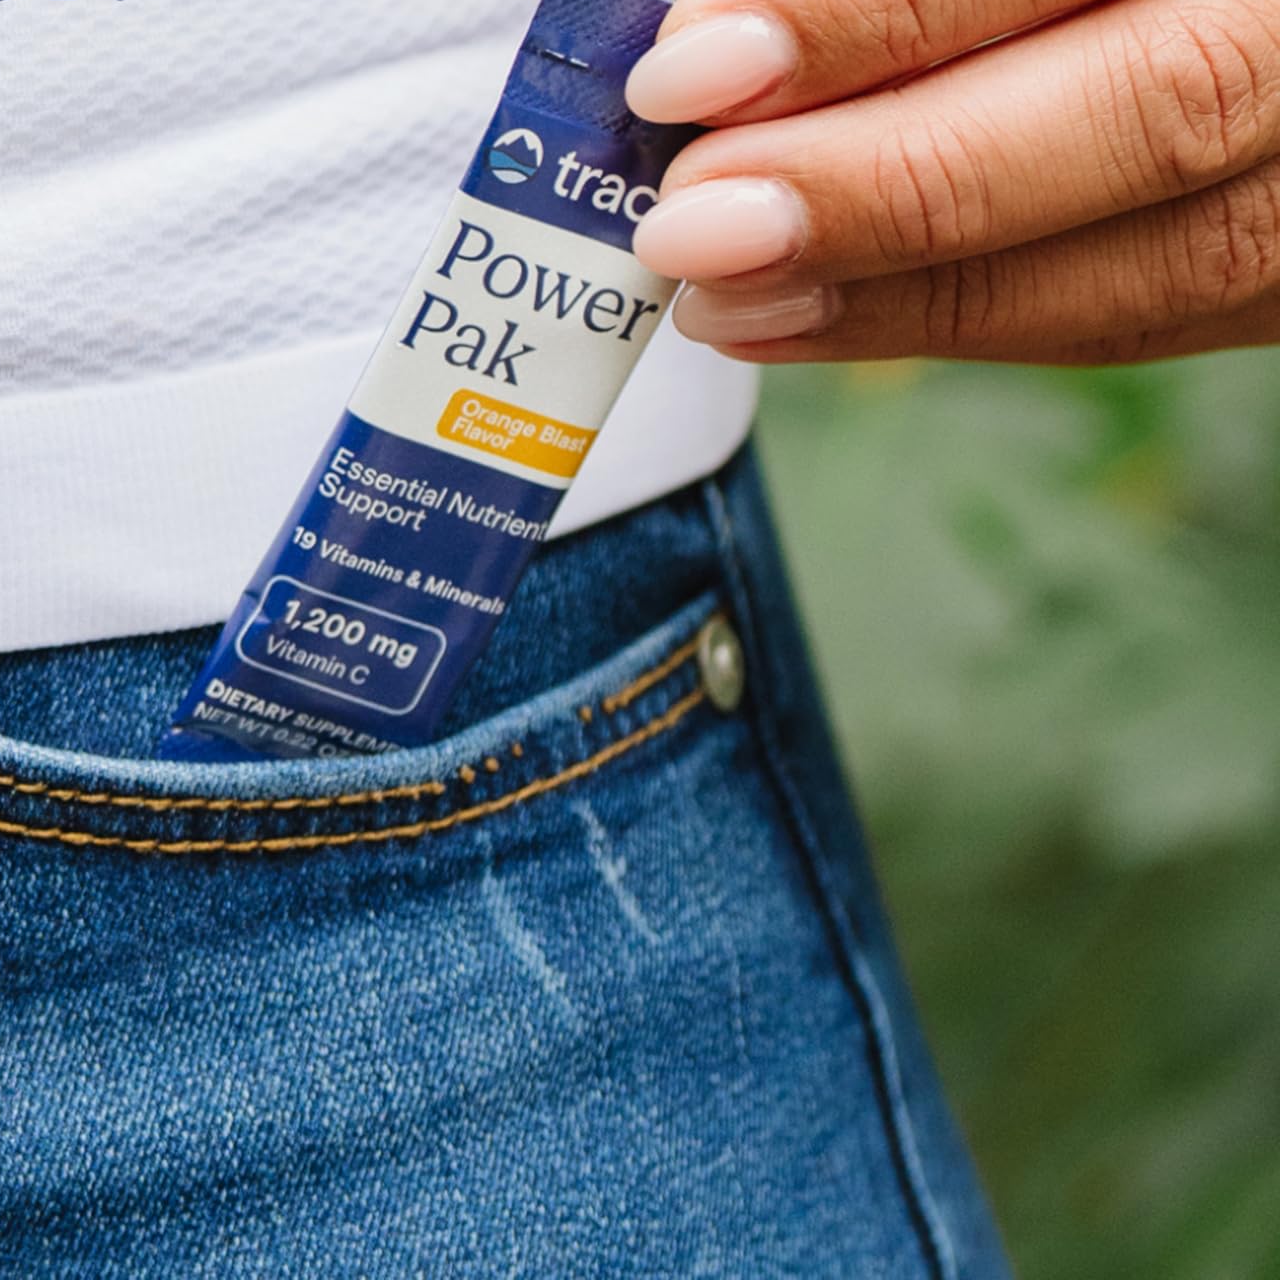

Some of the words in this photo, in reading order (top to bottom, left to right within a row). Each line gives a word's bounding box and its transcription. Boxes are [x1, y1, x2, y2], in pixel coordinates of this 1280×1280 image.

[435, 219, 660, 342] Power
[399, 290, 538, 386] Pak
[451, 415, 516, 451] Flavor
[461, 399, 536, 438] Orange
[538, 425, 588, 453] Blast
[318, 472, 428, 532] Support
[330, 447, 448, 510] Essential
[292, 525, 318, 551] 19
[320, 538, 405, 584] Vitamins
[404, 569, 422, 590] &
[422, 575, 506, 615] Minerals
[265, 634, 347, 680] Vitamin
[348, 665, 371, 686] C
[284, 599, 367, 646] 1,200
[367, 632, 418, 669] mg
[192, 701, 239, 725] NET
[238, 717, 274, 738] WT
[205, 677, 295, 723] DIETARY
